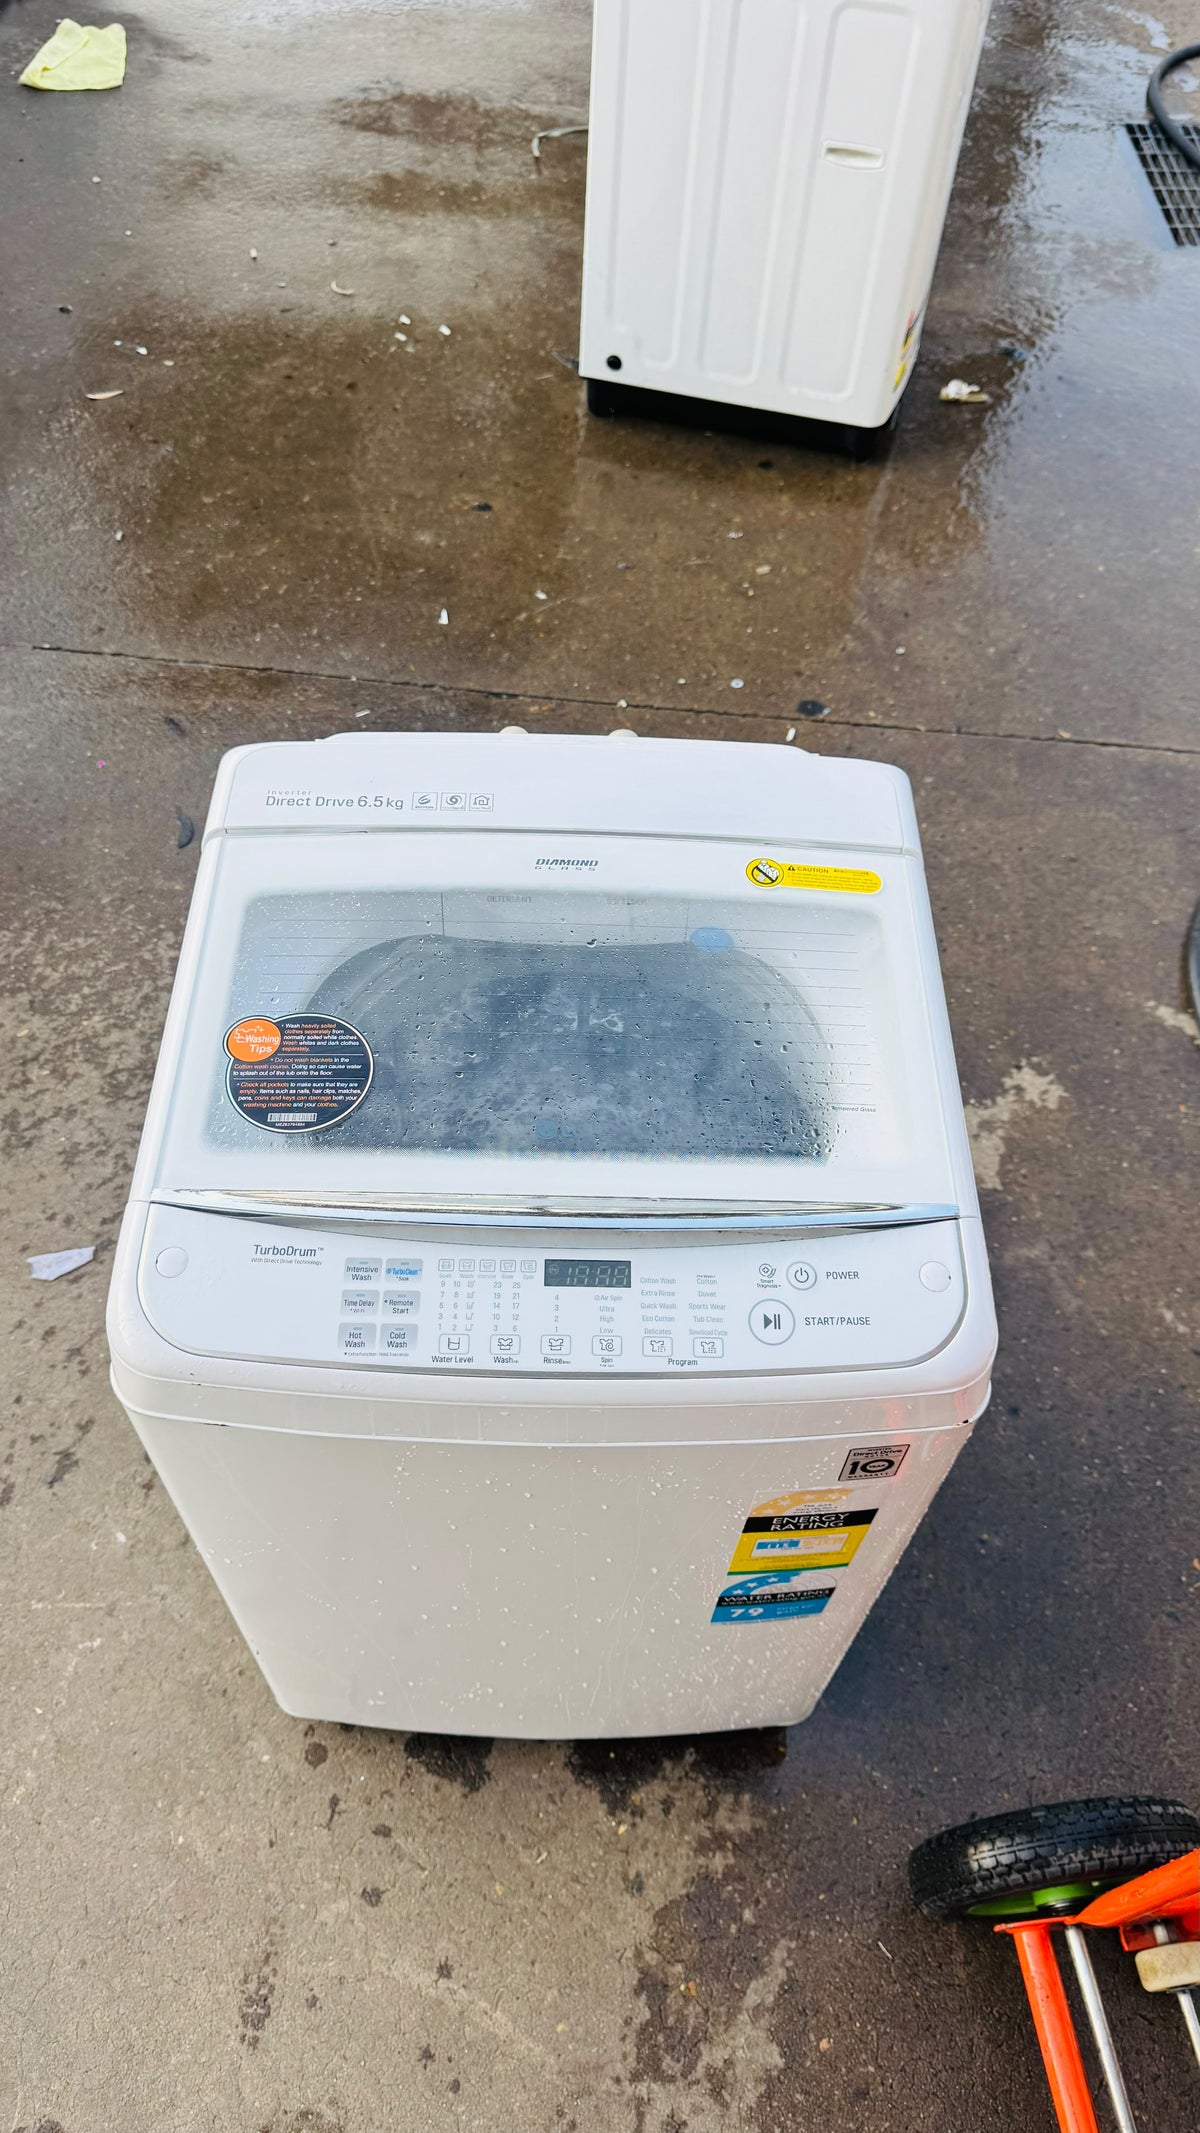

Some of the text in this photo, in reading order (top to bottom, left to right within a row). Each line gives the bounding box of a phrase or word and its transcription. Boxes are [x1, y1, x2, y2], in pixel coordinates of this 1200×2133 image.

[266, 795, 311, 807] Direct
[315, 796, 354, 807] Drive
[535, 858, 599, 867] DIAMOND
[797, 866, 829, 874] CAUTION
[245, 1034, 280, 1045] Washing
[249, 1044, 273, 1054] Tips
[346, 1265, 379, 1273] Intensive
[351, 1273, 372, 1281] Wash
[826, 1271, 860, 1280] POWER
[493, 1281, 502, 1289] 23
[512, 1281, 521, 1289] 25
[640, 1289, 658, 1297] Extra
[343, 1299, 375, 1308] Time Delay
[388, 1299, 414, 1307] Remote
[640, 1302, 659, 1310] Quick
[554, 1304, 559, 1312] 3
[438, 1312, 443, 1320] 3
[493, 1313, 500, 1321] 10
[512, 1313, 519, 1321] 12
[599, 1315, 614, 1323] High
[804, 1316, 872, 1326] START/PAUSE
[493, 1324, 498, 1332] 3
[348, 1331, 362, 1339] Hot
[389, 1331, 406, 1339] Cold
[344, 1340, 366, 1348] Wash
[431, 1355, 453, 1363] Water
[601, 1356, 613, 1364] Spin
[667, 1358, 698, 1367] Program
[848, 1458, 895, 1475] 10
[772, 1512, 850, 1525] ENERGY
[770, 1520, 844, 1531] RATING
[724, 1594, 772, 1602] WATER
[777, 1589, 830, 1599] RATING
[729, 1607, 764, 1618] 79
